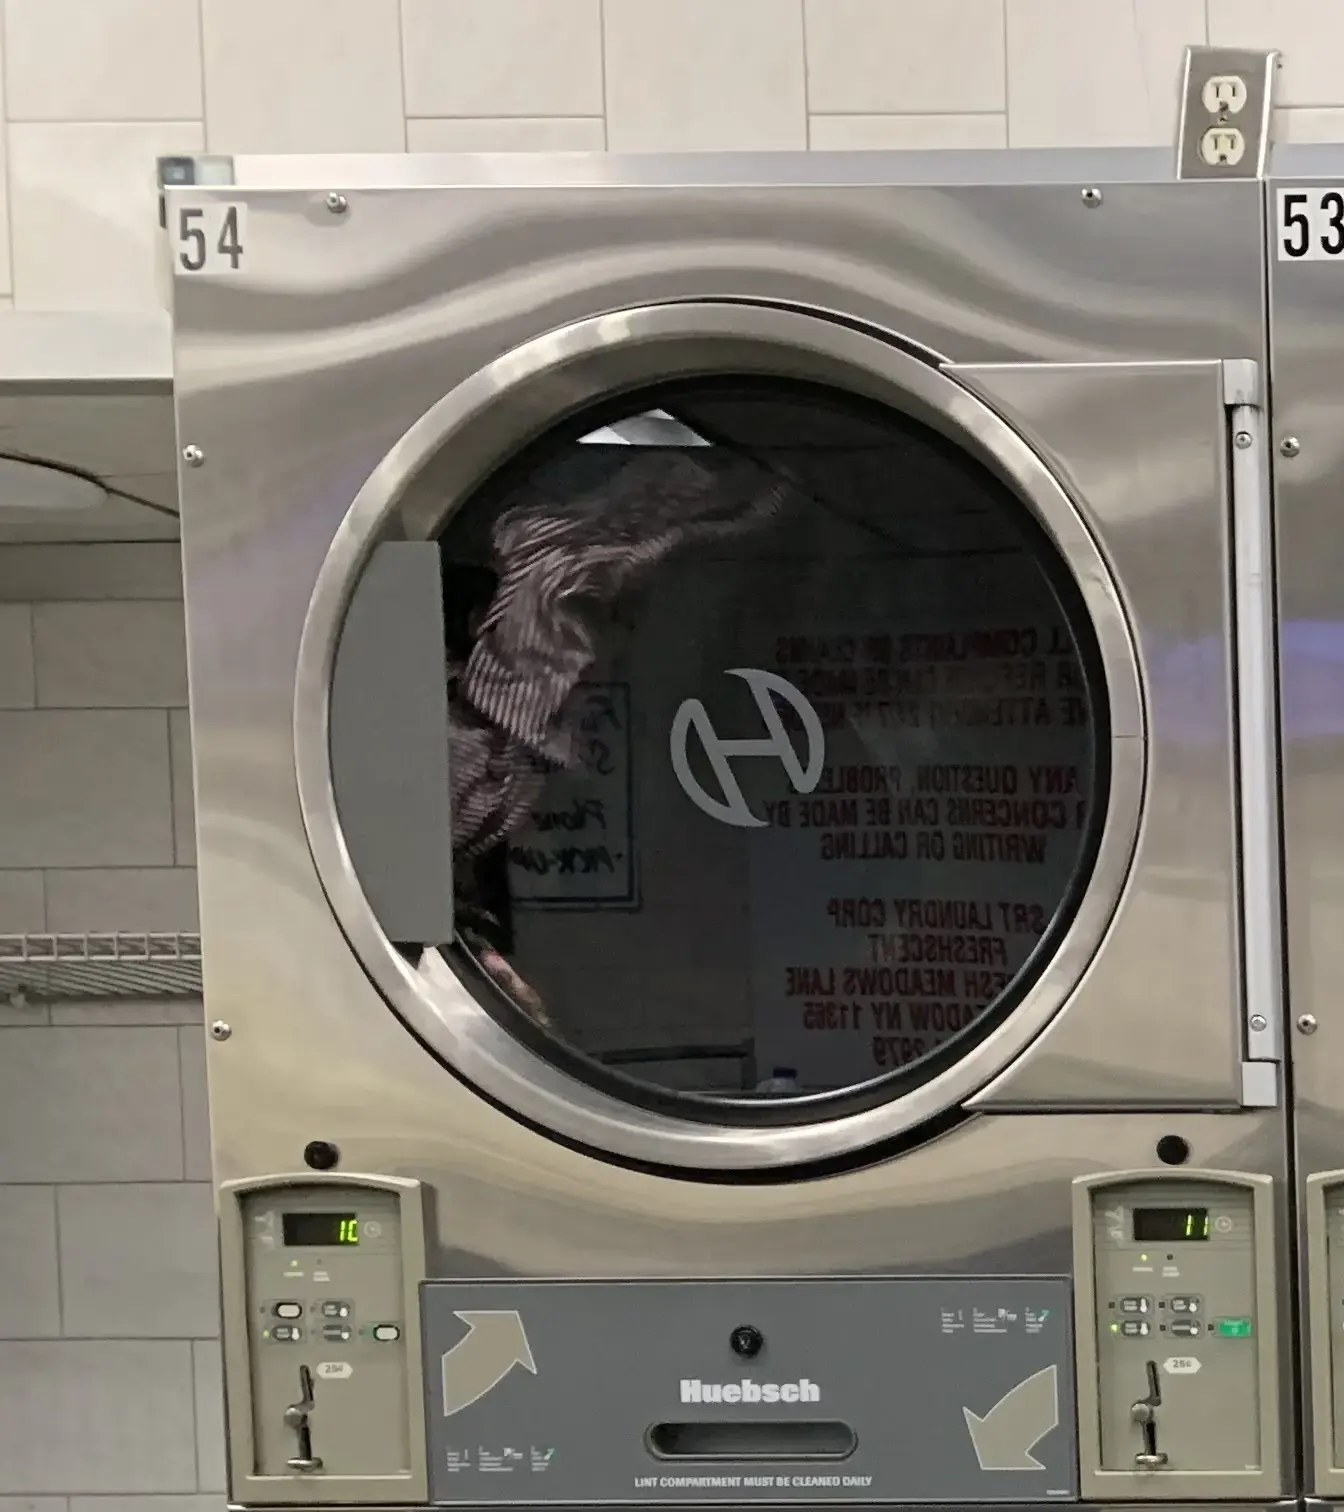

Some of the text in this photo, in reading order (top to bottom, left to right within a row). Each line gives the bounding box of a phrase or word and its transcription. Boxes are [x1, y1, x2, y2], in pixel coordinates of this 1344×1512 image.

[180, 206, 243, 271] 54
[679, 1378, 821, 1402] Huebsch
[634, 1475, 873, 1488] LINT COMPARTMENT MUST BE CLEANED DAILY
